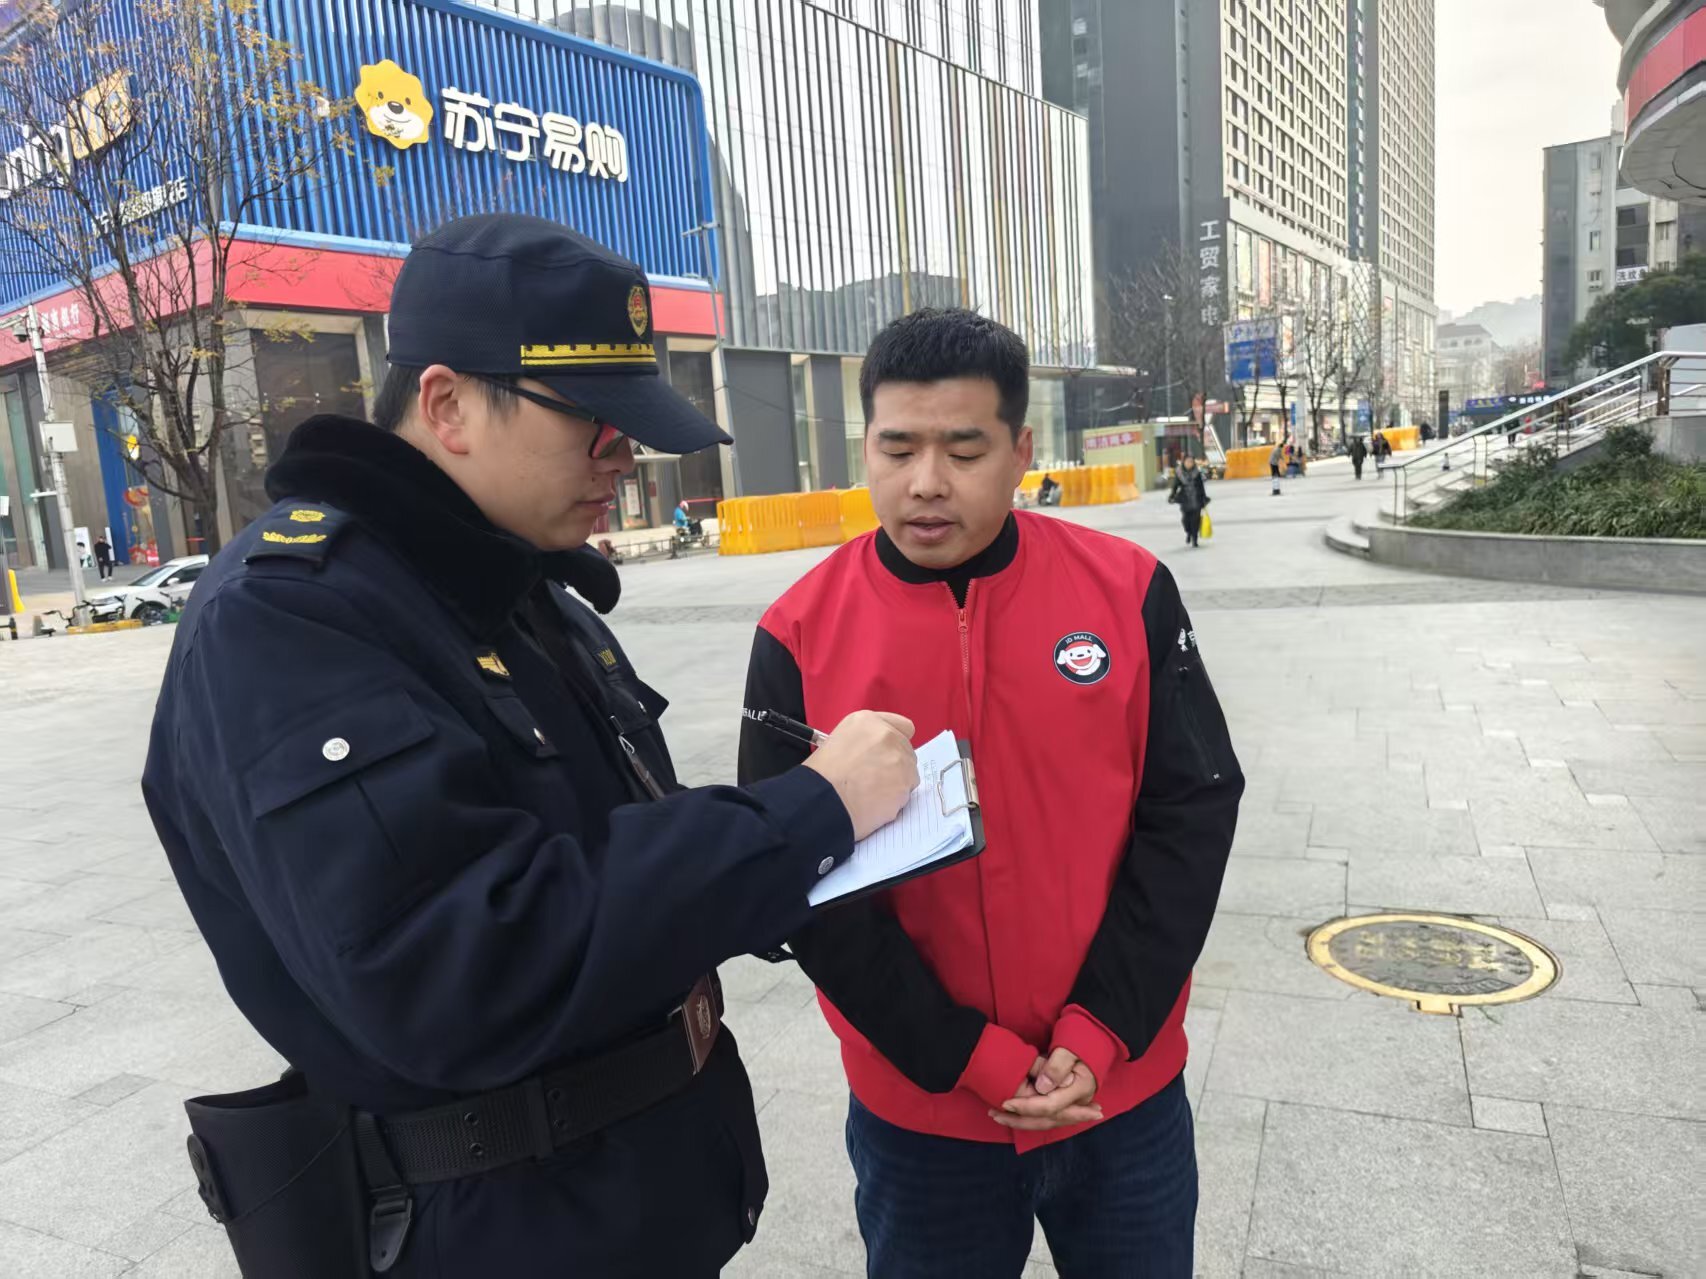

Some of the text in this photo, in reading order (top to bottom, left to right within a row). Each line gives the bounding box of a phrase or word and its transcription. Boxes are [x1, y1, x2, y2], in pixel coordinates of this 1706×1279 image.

[441, 86, 629, 183] 苏宁易购
[1199, 219, 1221, 327] 工贸家电
[1073, 634, 1093, 642] MALL
